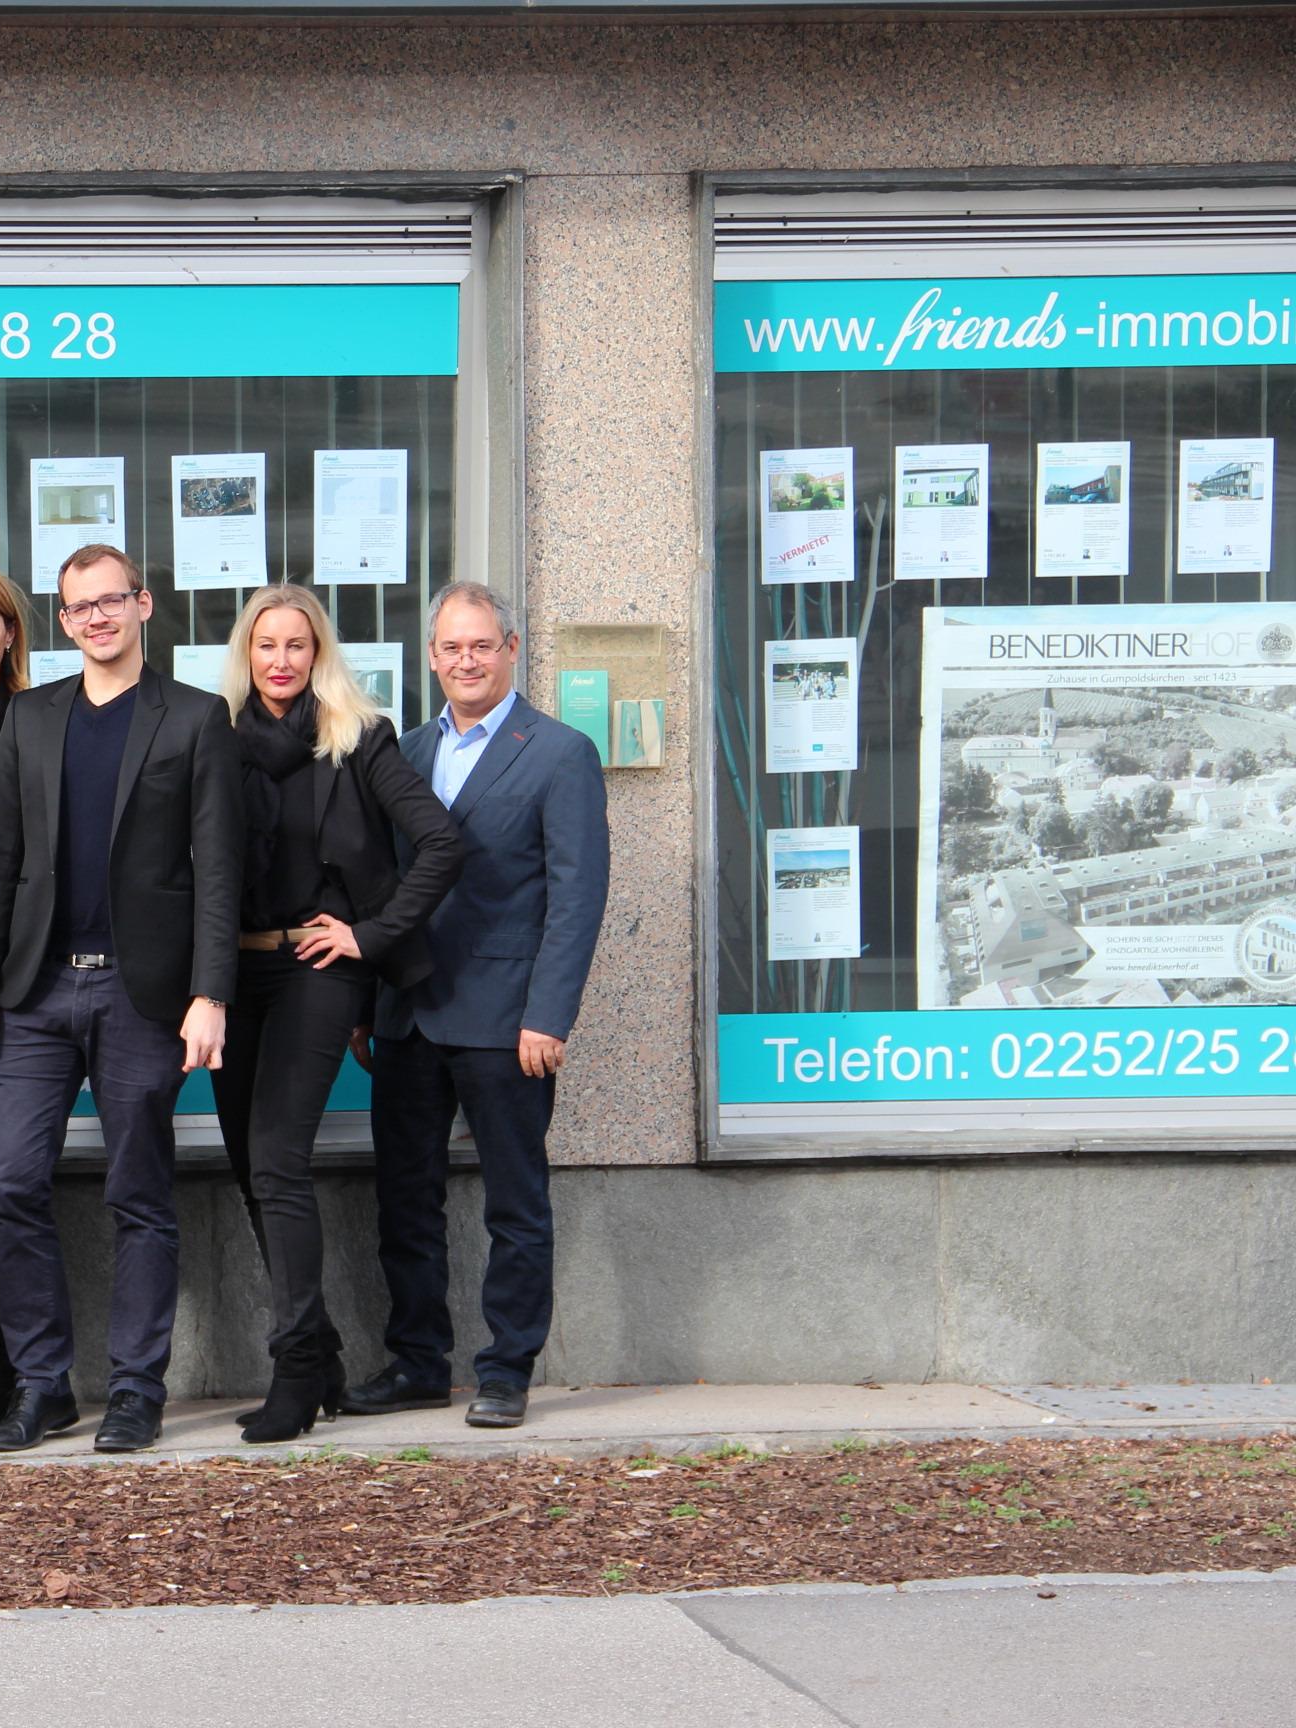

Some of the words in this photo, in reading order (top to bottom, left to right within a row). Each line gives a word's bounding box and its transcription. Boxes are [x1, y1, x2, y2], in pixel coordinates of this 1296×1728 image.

[51, 311, 117, 360] 28
[779, 534, 831, 564] VERMIETET
[1046, 673, 1088, 684] Zuhause
[1089, 674, 1099, 683] in
[1100, 672, 1185, 686] Gumpoldskirchen
[1192, 673, 1209, 682] seit
[1212, 672, 1237, 682] 1423
[764, 1034, 969, 1083] Telefon:
[990, 1028, 1240, 1079] 02252/25
[1259, 1027, 1296, 1073] 2
